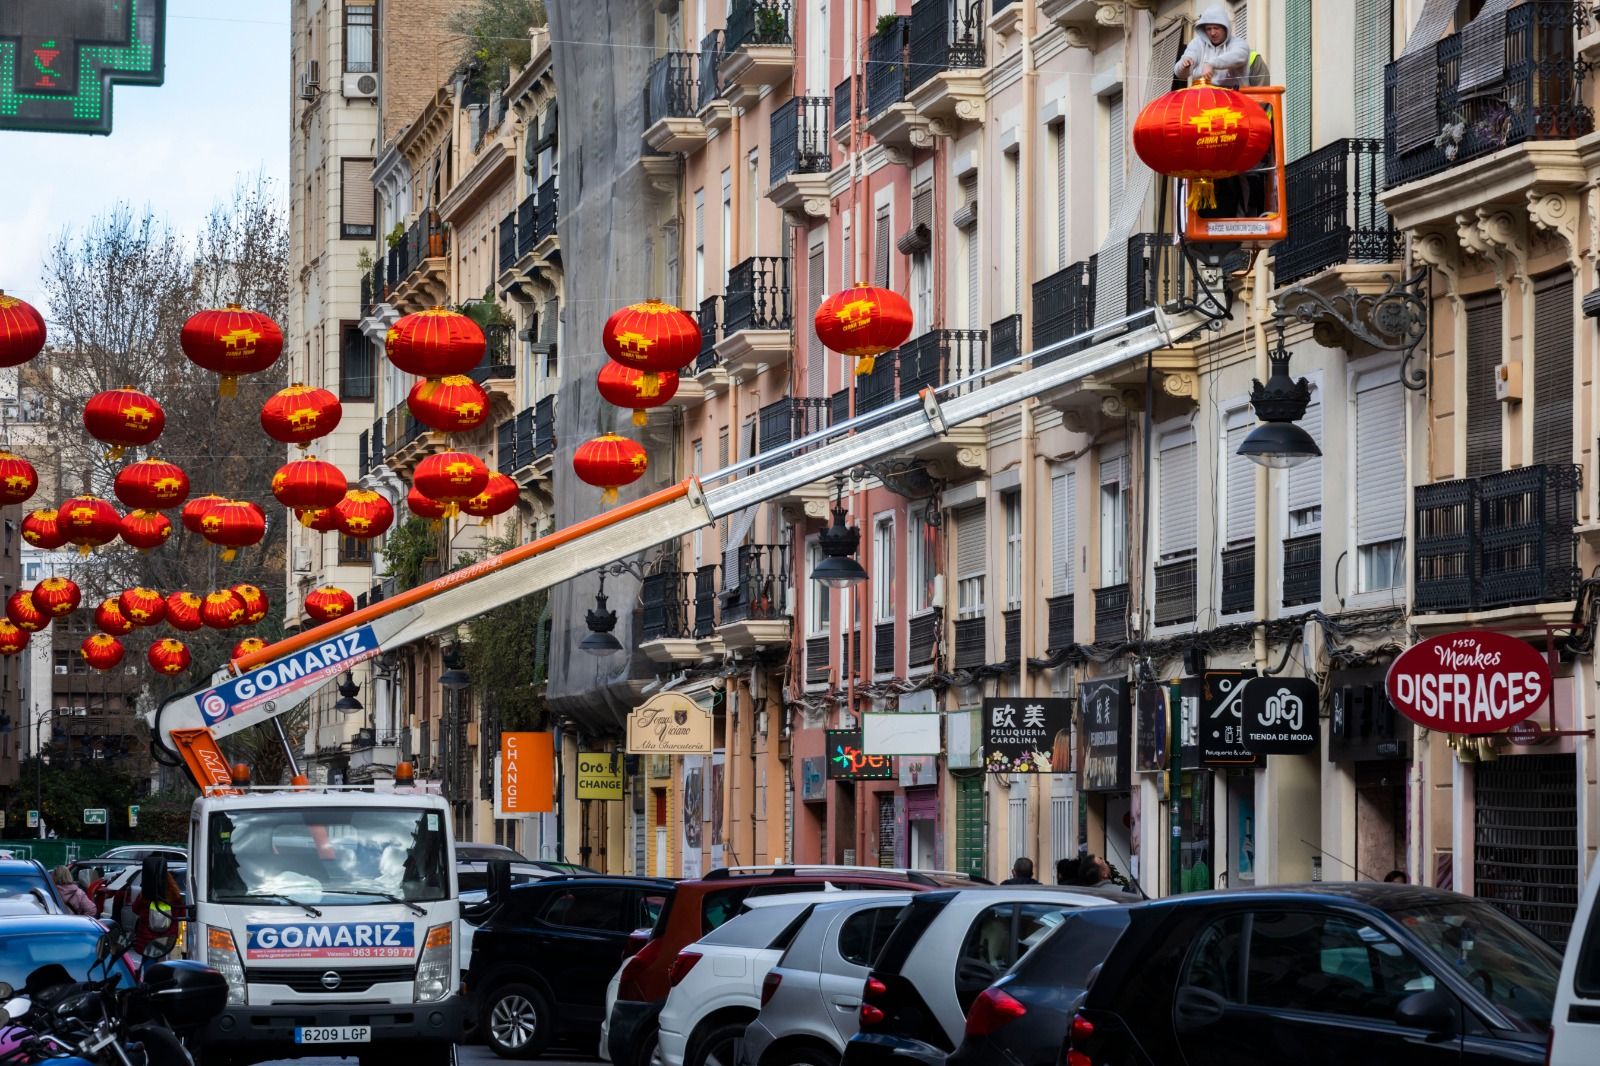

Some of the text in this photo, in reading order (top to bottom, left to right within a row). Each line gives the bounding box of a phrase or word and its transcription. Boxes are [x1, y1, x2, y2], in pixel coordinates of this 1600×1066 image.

[1220, 132, 1238, 142] TOWN
[1453, 638, 1476, 648] 1950
[235, 632, 366, 700] GOMARIZ
[1434, 644, 1502, 671] Menkes
[1398, 672, 1542, 722] DISFRACES
[507, 737, 518, 808] CHANGE
[579, 780, 621, 790] CHANGE
[257, 925, 401, 948] GOMARIZ
[352, 949, 371, 957] 963
[373, 949, 386, 957] 12
[387, 949, 400, 957] 99
[402, 948, 413, 956] 77
[304, 1028, 368, 1040] 6209 LGP
